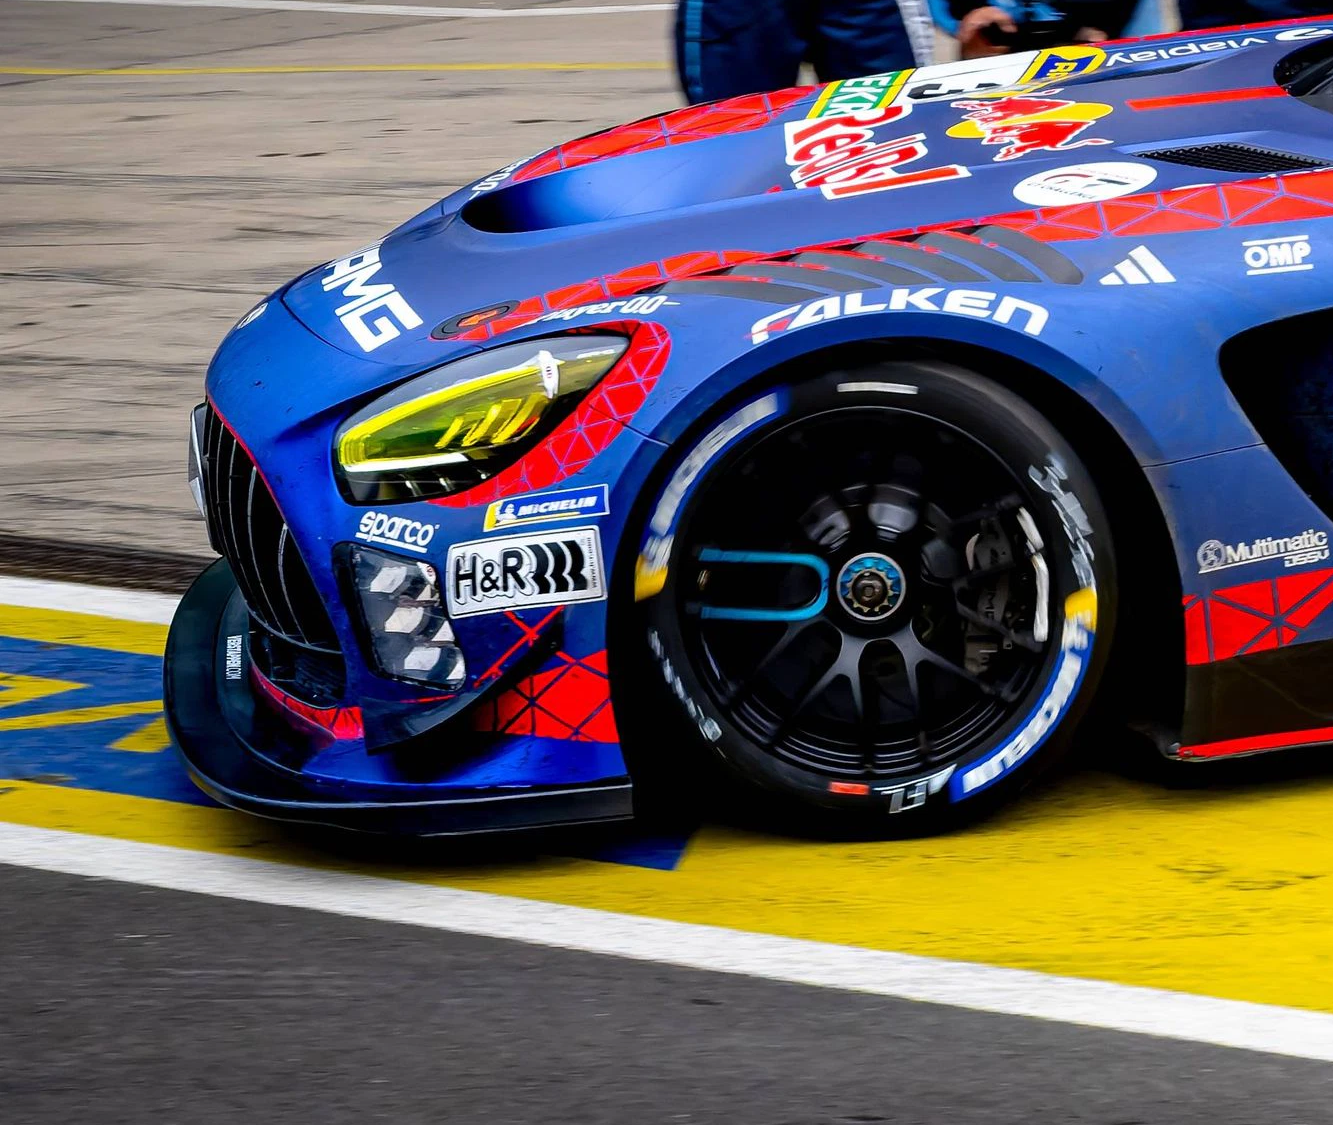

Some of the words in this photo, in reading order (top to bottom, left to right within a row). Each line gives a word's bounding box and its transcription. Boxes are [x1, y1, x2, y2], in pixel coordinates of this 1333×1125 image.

[1106, 36, 1268, 67] viaplay
[1244, 242, 1312, 268] OMP
[749, 287, 1050, 346] FALKEN
[516, 496, 598, 517] MICHELIN
[357, 511, 434, 550] sparco
[1226, 529, 1328, 564] Multimatic
[454, 547, 532, 604] H&R
